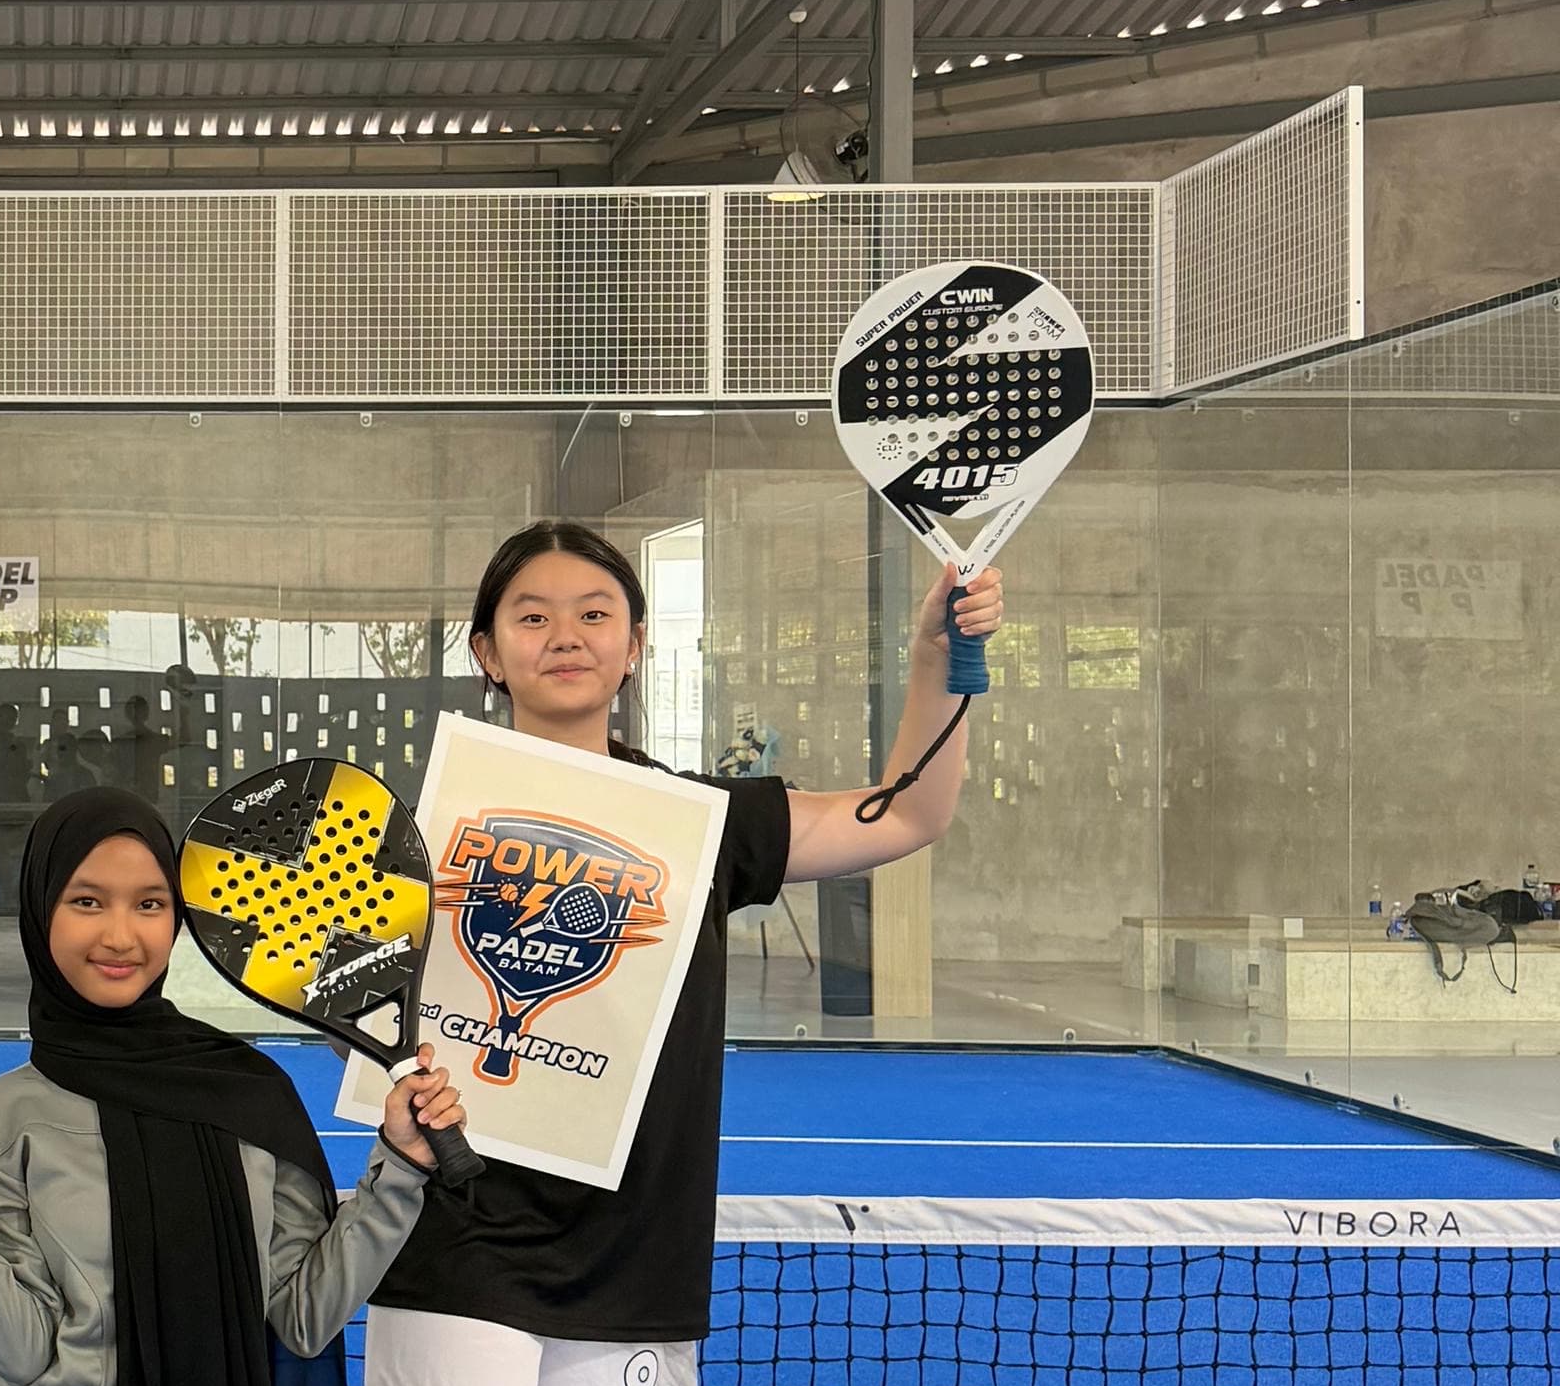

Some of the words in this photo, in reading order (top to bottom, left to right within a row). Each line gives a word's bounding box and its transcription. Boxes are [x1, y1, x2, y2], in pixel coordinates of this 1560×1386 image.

[922, 307, 963, 316] CUSTOM
[940, 287, 993, 305] CWIN
[855, 318, 888, 348] SUPER
[887, 290, 924, 323] POWER
[1026, 311, 1062, 341] FOAM
[913, 464, 1020, 490] 4015
[453, 832, 661, 899] POWER
[476, 931, 584, 969] PADEL
[498, 957, 561, 977] BATAM
[302, 933, 411, 1006] X-FORCE
[323, 976, 359, 999] PADEL
[372, 956, 398, 974] BALL
[440, 1013, 608, 1079] CHAMPION
[1284, 1210, 1461, 1237] VIBORA
